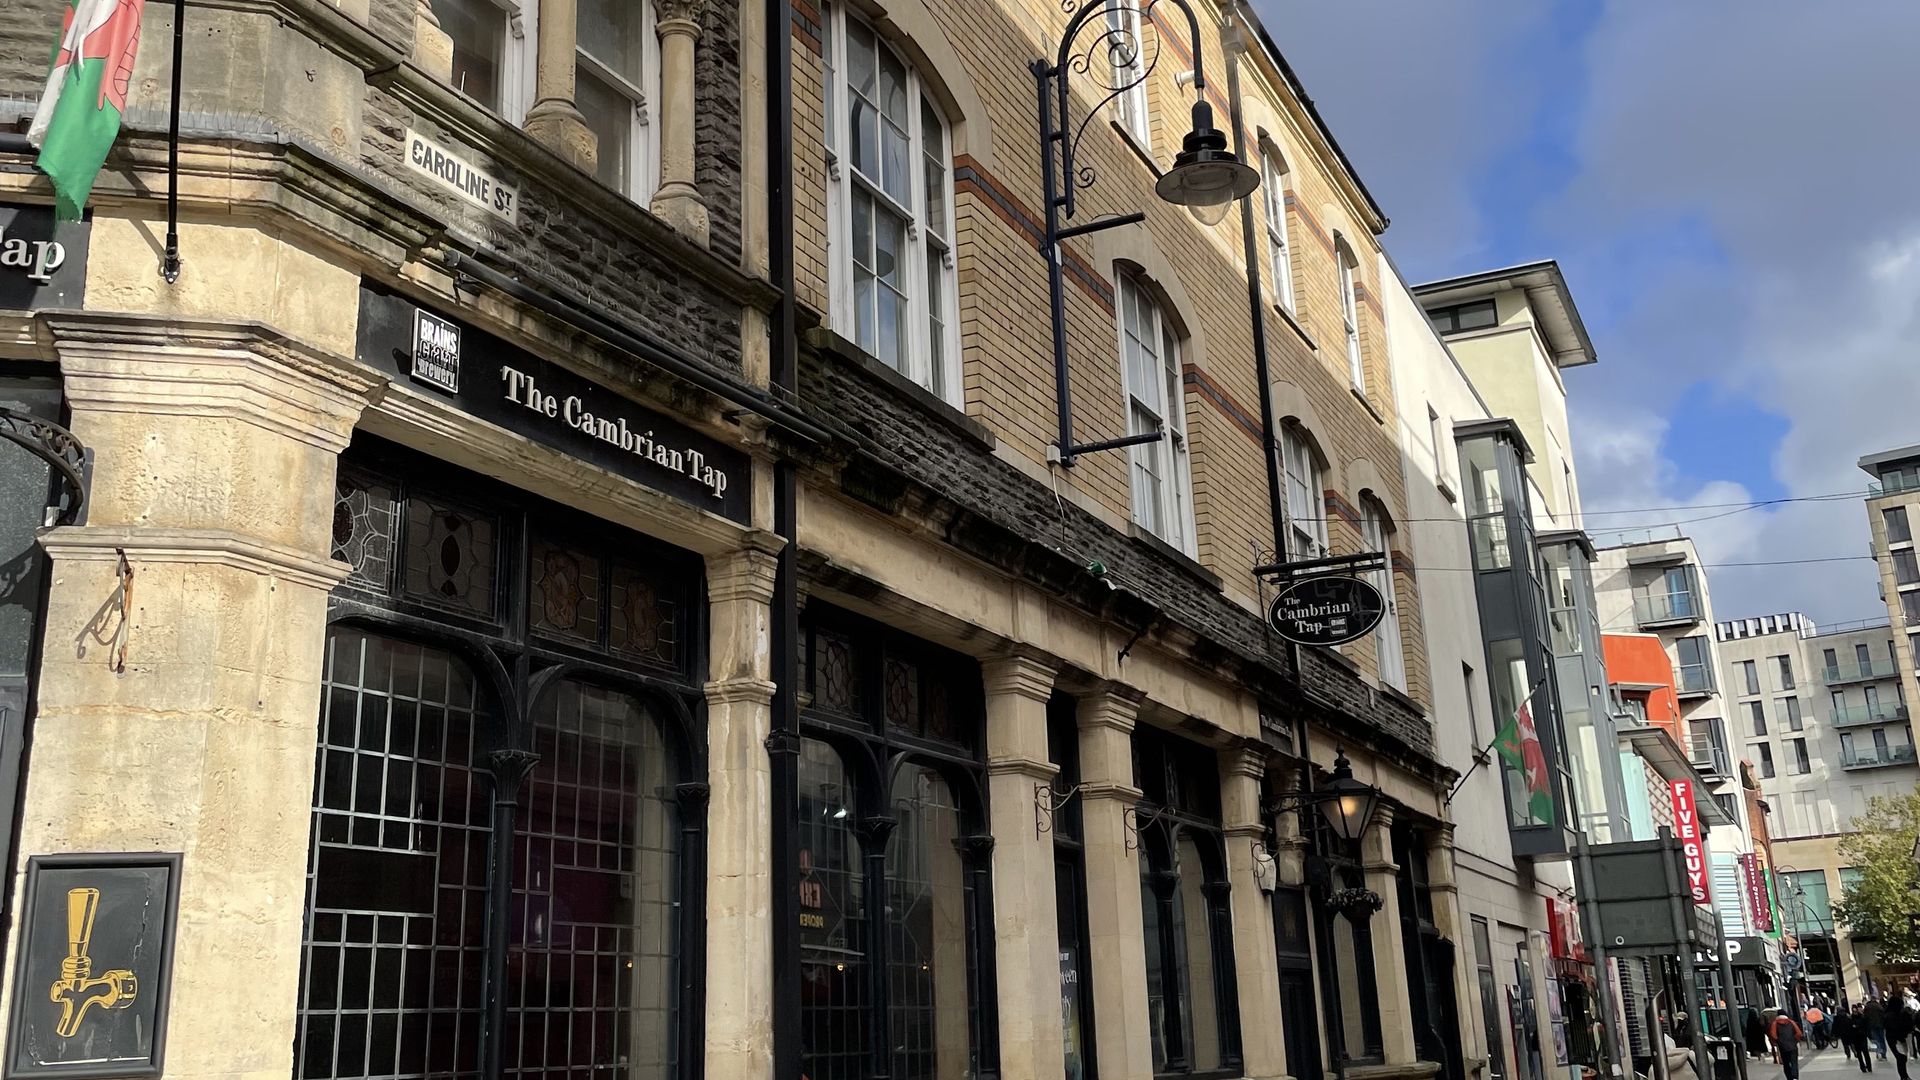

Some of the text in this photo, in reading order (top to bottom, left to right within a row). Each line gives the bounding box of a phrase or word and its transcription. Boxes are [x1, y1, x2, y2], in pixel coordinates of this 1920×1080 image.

[412, 139, 490, 204] CAROLINE
[0, 226, 66, 279] ap
[501, 365, 727, 499] The Cambrian Tap
[1277, 602, 1351, 621] Cambrian
[1284, 597, 1300, 606] The
[1295, 620, 1323, 635] Tap
[1675, 783, 1706, 901] FIVE GUYS
